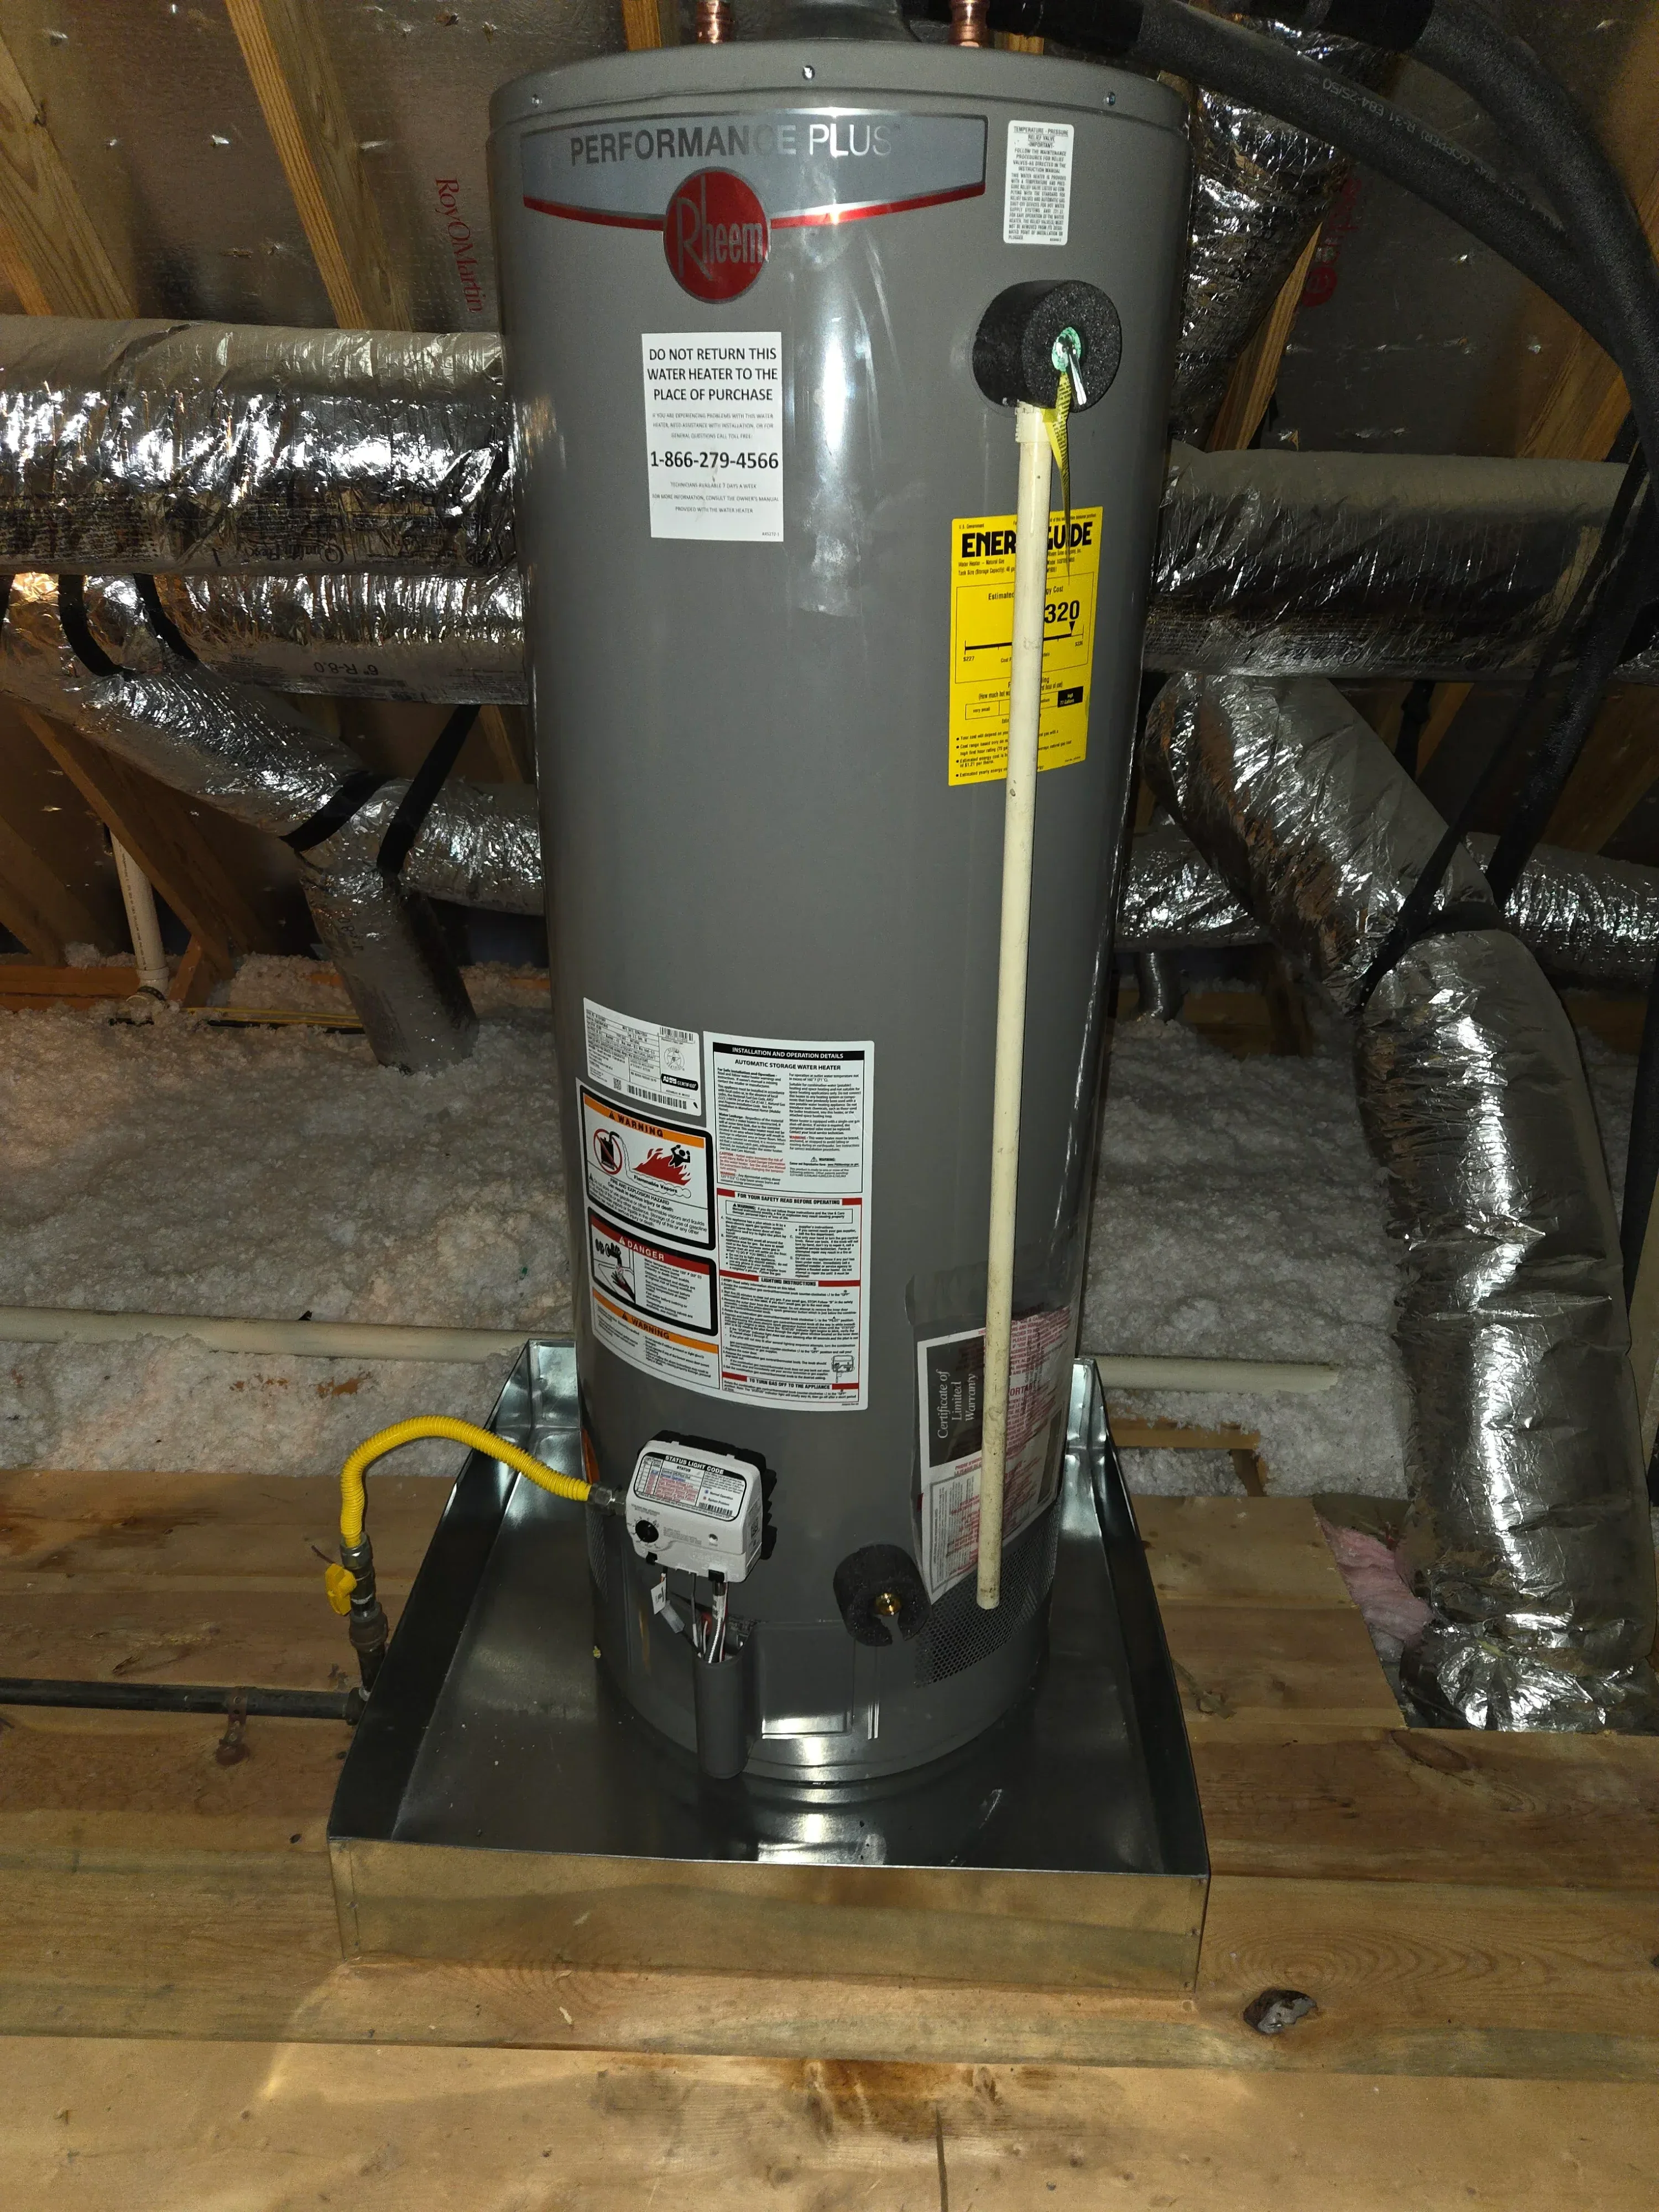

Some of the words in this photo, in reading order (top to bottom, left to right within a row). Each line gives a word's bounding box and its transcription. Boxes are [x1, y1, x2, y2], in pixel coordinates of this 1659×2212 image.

[571, 124, 796, 166] PERFORMANCE
[809, 123, 892, 158] PLUS
[676, 174, 764, 280] Rheem
[650, 349, 665, 360] DO
[670, 348, 693, 360] NOT
[697, 348, 745, 360] RETURN
[749, 348, 776, 359] THIS
[648, 369, 685, 380] WATER
[689, 368, 732, 380] HEATER
[735, 368, 752, 380] TO
[755, 368, 778, 380] THE
[654, 389, 686, 400] PLACE
[690, 389, 705, 400] OF
[709, 389, 773, 401] PURCHASE
[651, 451, 779, 469] 1-866-279-4566
[314, 661, 358, 675] R-8.0
[732, 1047, 771, 1056] INSTALLATION
[618, 1114, 664, 1138] WARNING
[634, 1175, 659, 1188] Flammable
[660, 1184, 677, 1193] Vapors
[627, 1186, 650, 1198] EXPLOSION
[651, 1194, 669, 1205] HAZARD
[628, 1240, 664, 1261] DANGER
[632, 1316, 670, 1340] WARNING
[936, 1369, 951, 1381] of
[951, 1381, 962, 1421] Limited
[966, 1373, 978, 1421] Warranty
[937, 1384, 951, 1438] Certificate
[665, 1455, 687, 1465] STATUS
[688, 1460, 706, 1469] LIGHT
[707, 1467, 724, 1475] CODE
